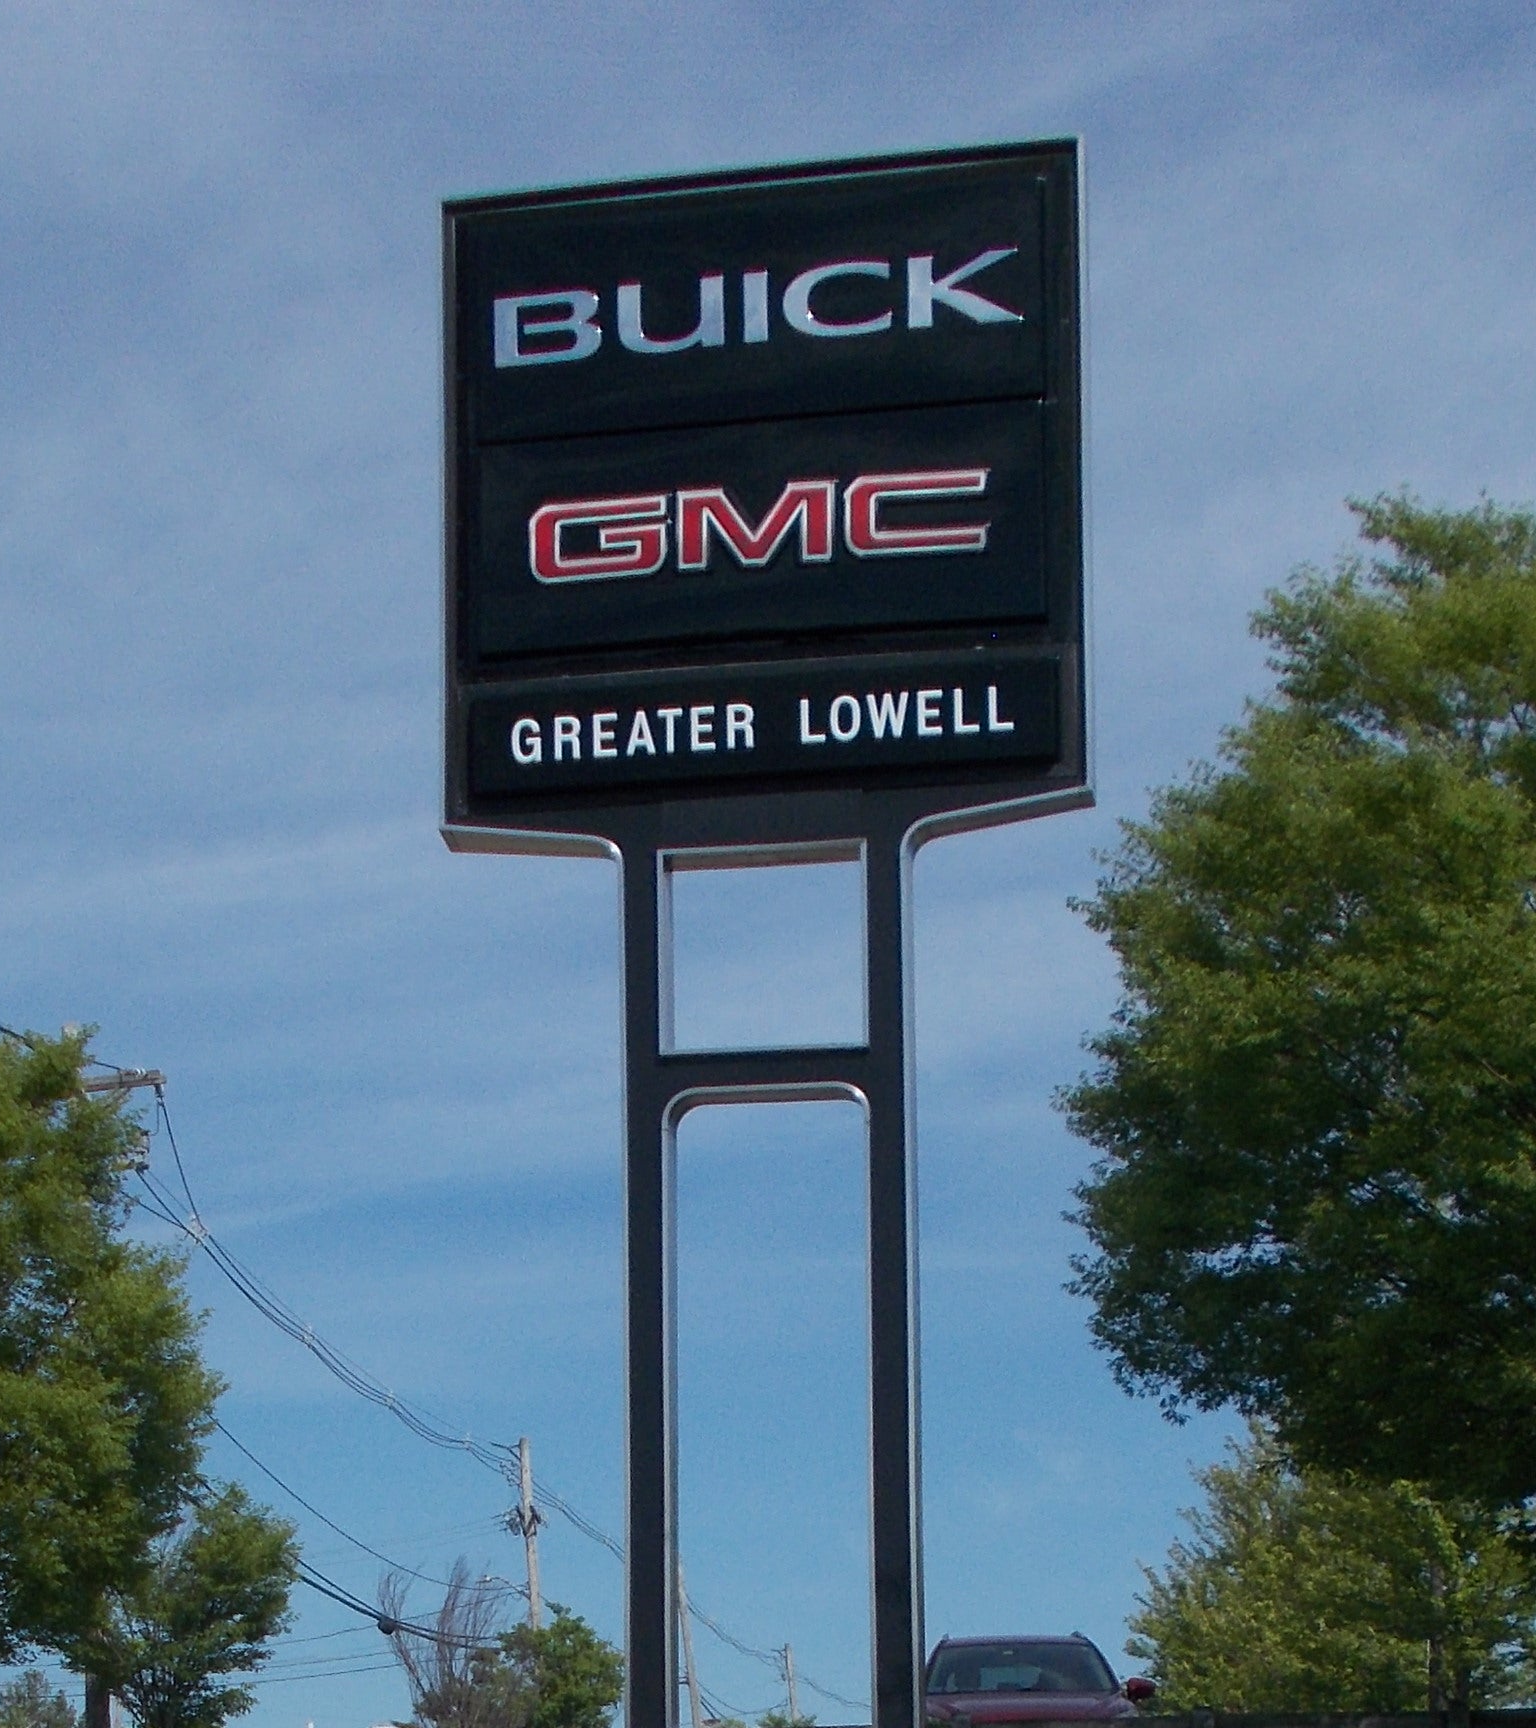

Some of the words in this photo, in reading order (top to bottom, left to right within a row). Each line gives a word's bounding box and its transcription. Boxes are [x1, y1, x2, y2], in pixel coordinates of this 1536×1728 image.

[493, 245, 1025, 369] BUICK
[528, 468, 991, 585] GMC
[510, 703, 755, 764] GREATER
[799, 686, 1015, 744] LOWELL
